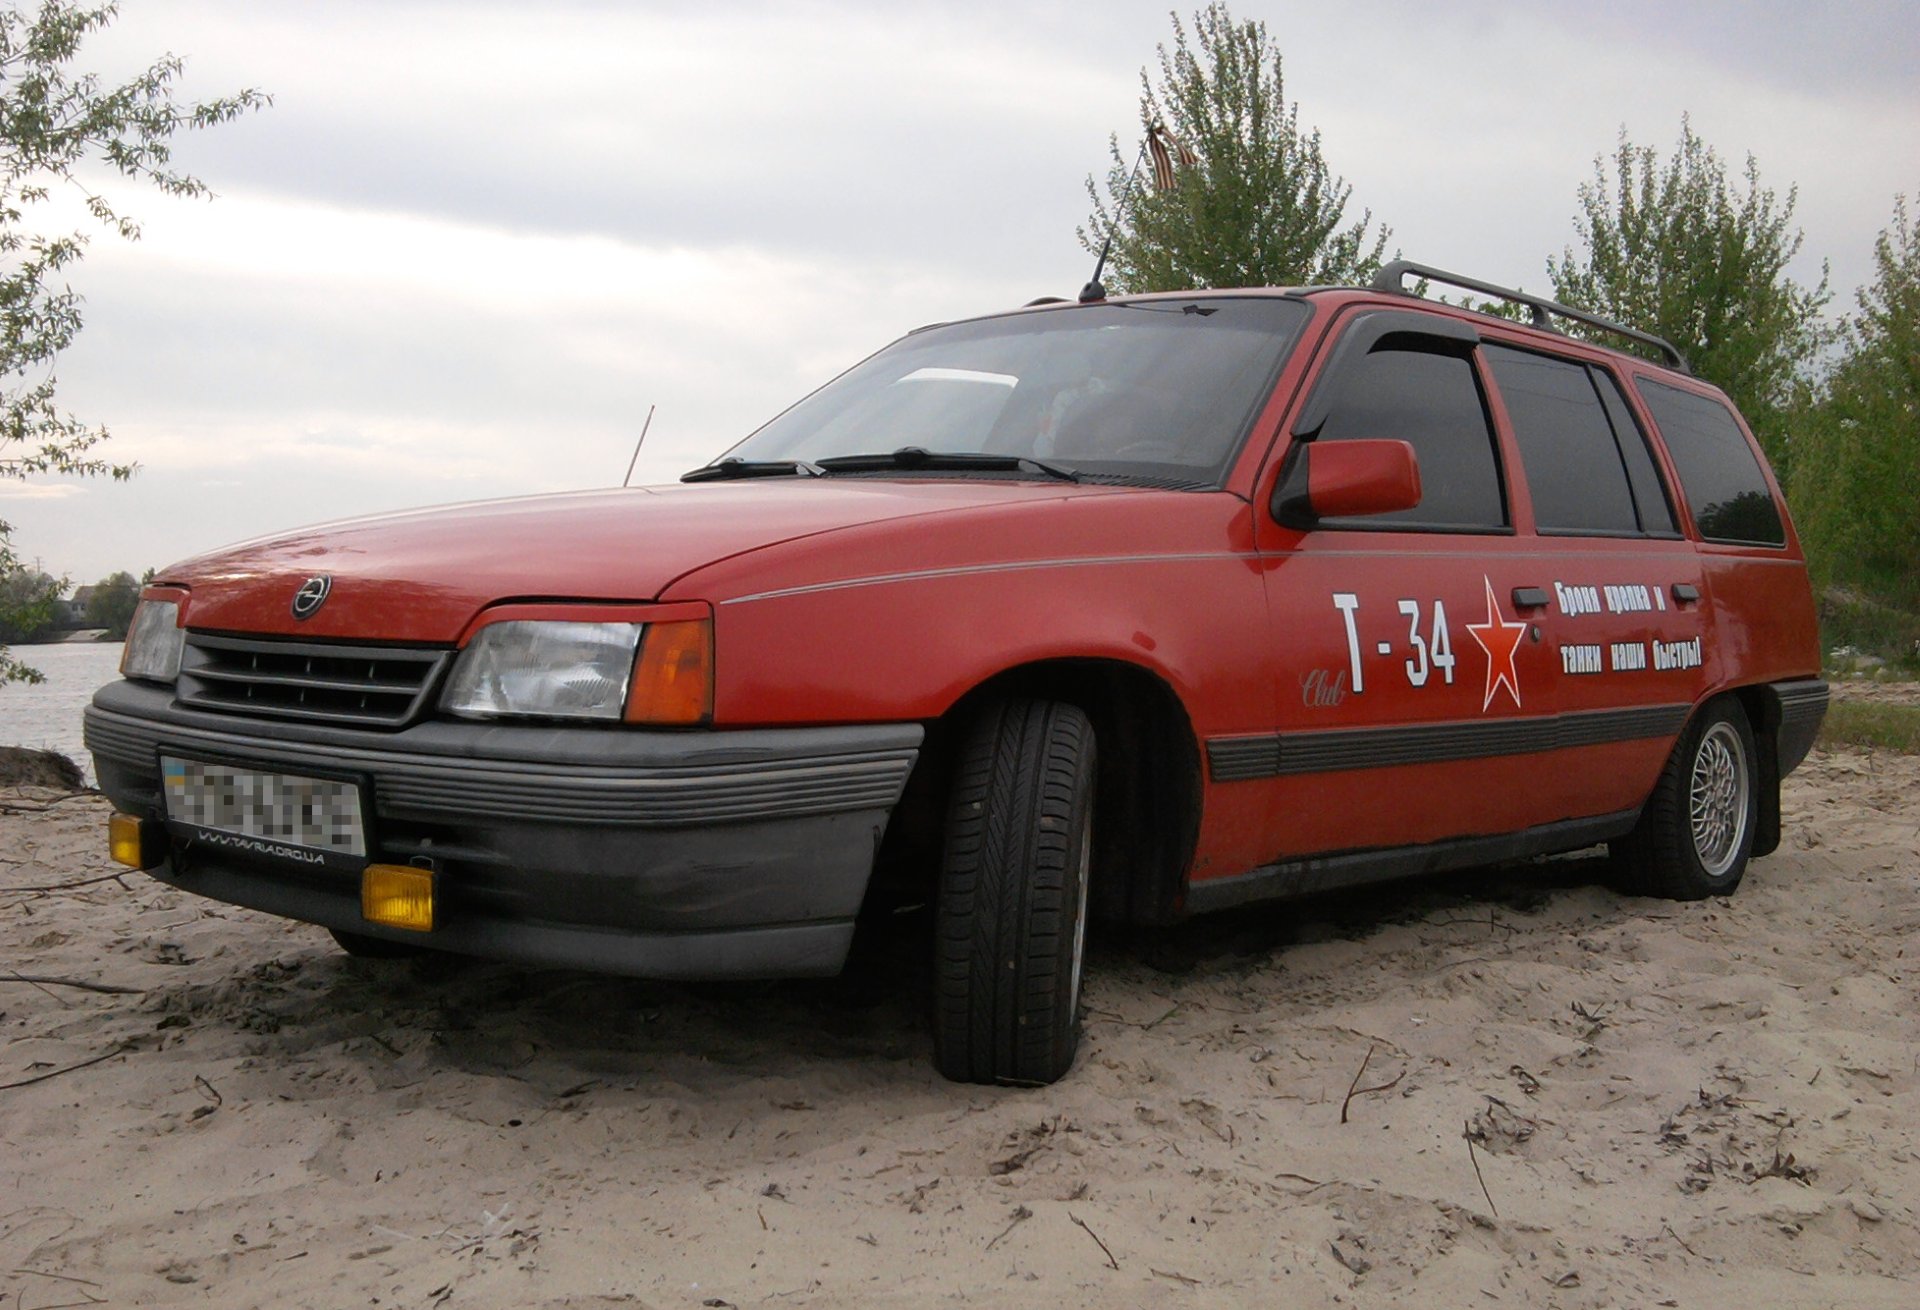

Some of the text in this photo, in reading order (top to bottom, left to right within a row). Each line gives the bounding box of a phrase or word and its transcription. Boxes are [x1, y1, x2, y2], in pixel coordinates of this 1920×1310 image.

[1554, 581, 1666, 617] Броня крепка и
[1560, 635, 1702, 674] танки наши быстры!
[1302, 669, 1346, 707] Club
